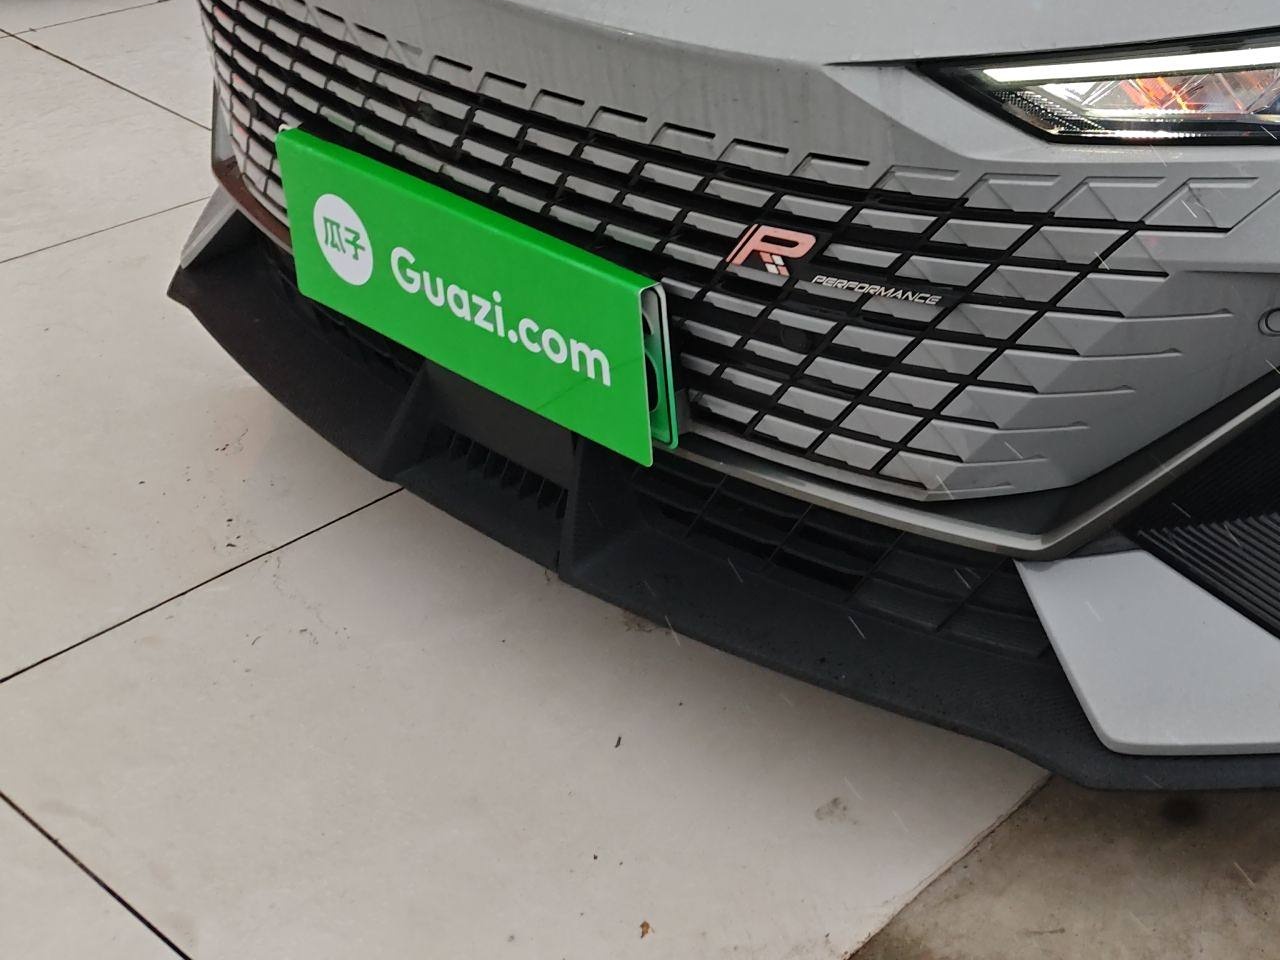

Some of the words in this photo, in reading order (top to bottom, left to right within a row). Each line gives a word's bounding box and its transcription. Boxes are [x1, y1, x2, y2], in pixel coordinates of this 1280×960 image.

[323, 217, 365, 261] 瓜子
[811, 274, 942, 305] PERFORMANCE
[391, 246, 611, 387] Guazi.com
